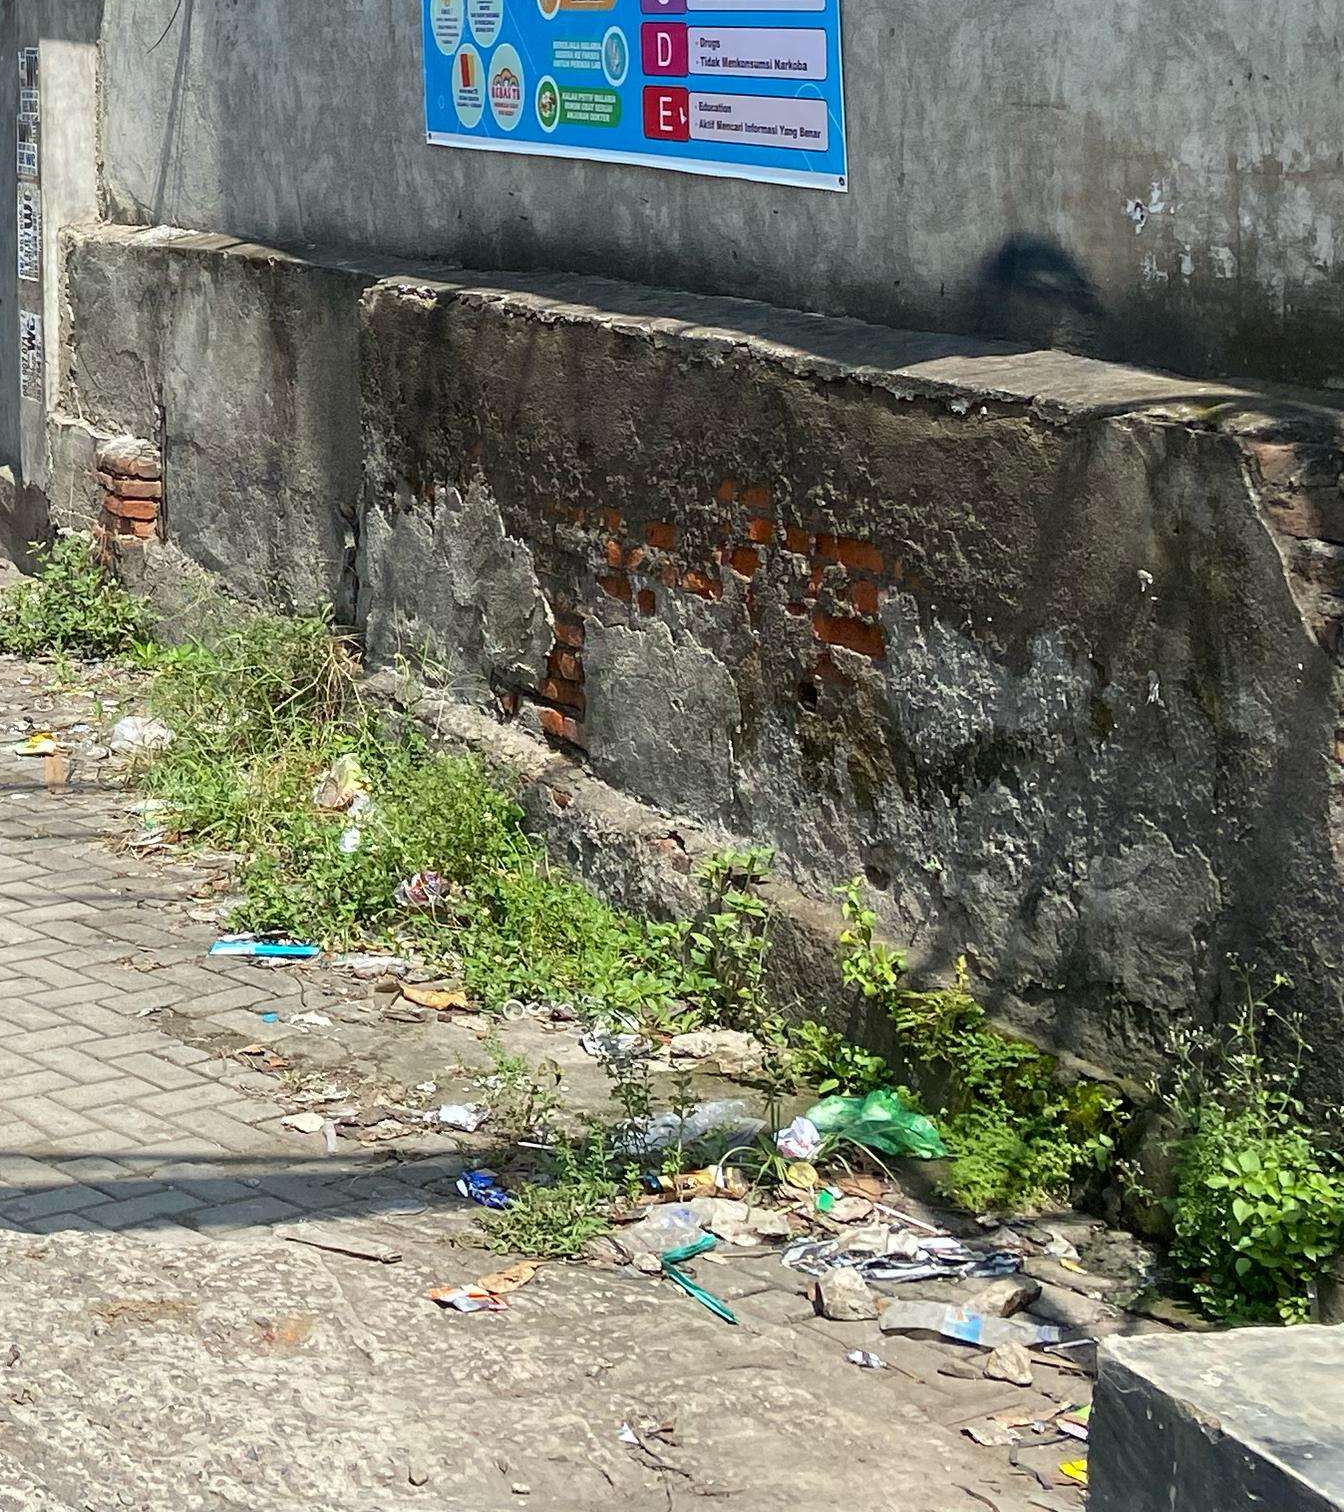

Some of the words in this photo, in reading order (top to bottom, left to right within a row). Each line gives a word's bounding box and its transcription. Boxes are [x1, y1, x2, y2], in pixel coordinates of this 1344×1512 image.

[657, 32, 672, 67] D
[699, 38, 720, 50] Drugs
[700, 57, 720, 67] Tidak
[774, 59, 807, 71] Narkoba
[659, 96, 673, 131] E
[698, 101, 731, 113] Education
[699, 119, 714, 129] Aktif
[745, 123, 777, 135] Informasi
[779, 126, 797, 138] Yang
[799, 128, 820, 139] Benar
[26, 317, 36, 351] WC
